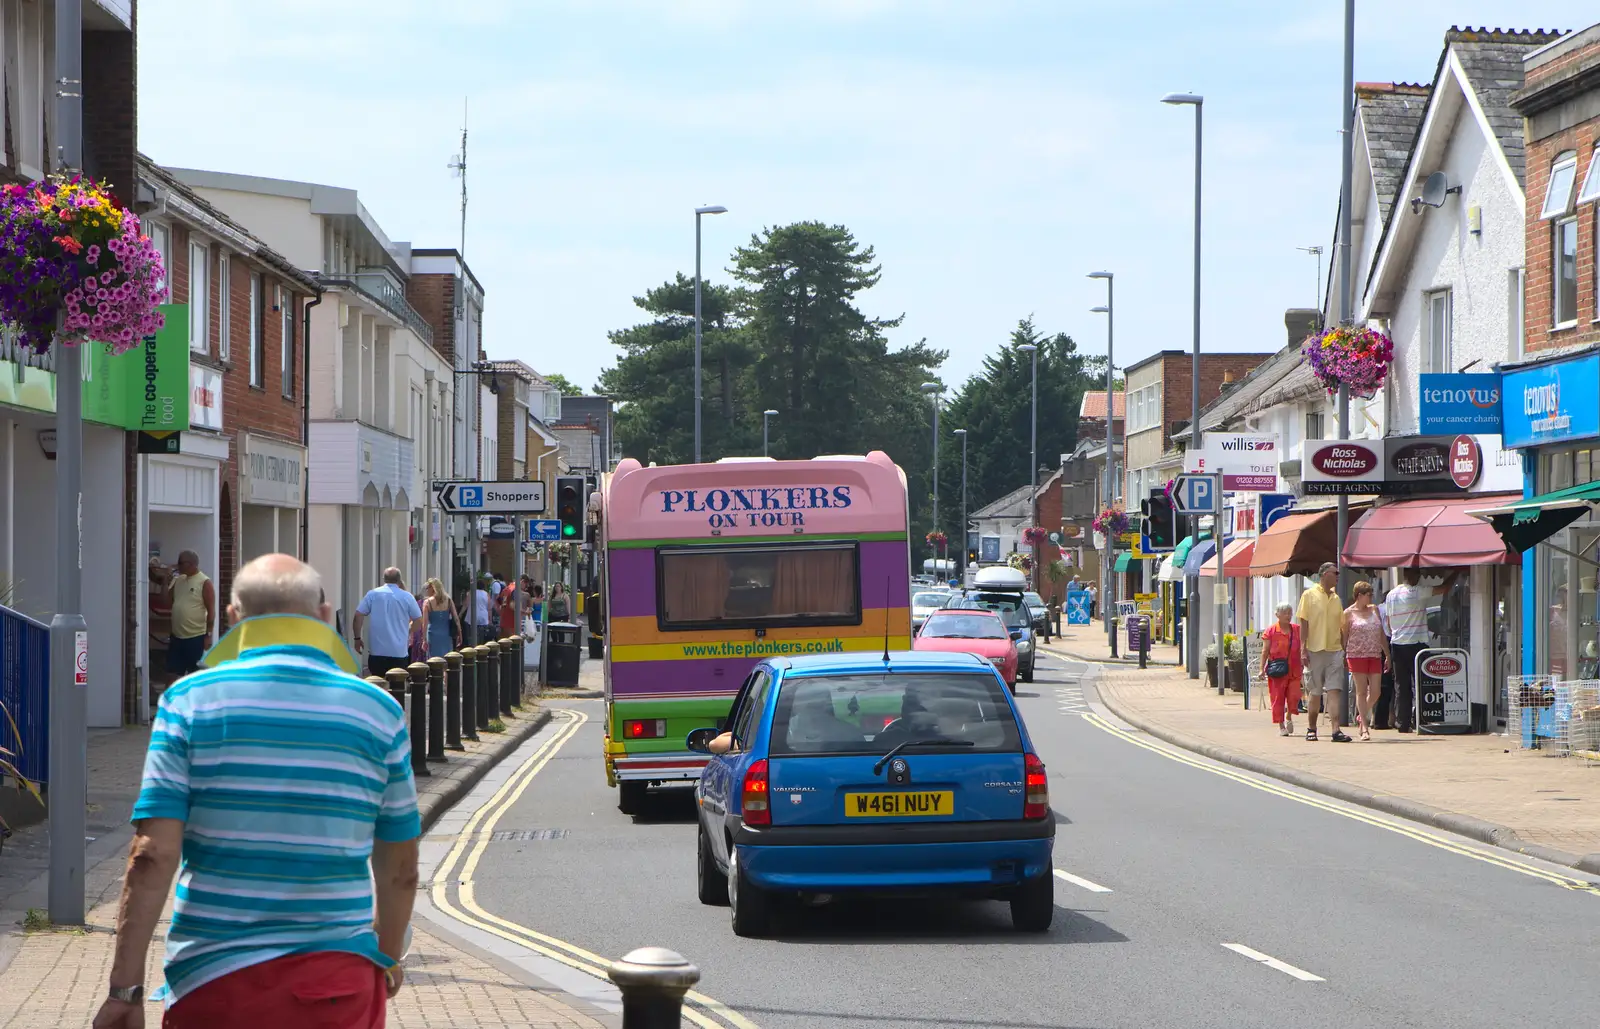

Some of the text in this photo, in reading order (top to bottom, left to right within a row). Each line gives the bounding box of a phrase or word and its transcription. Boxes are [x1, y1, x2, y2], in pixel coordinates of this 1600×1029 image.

[141, 334, 159, 427] The co-operat
[1424, 387, 1499, 404] tenovus
[1523, 382, 1557, 415] tenovus
[160, 396, 174, 425] food
[1426, 413, 1500, 425] your cancer charity
[1222, 438, 1254, 451] willis
[1331, 448, 1357, 458] Ross
[1457, 441, 1469, 457] Ross
[1322, 459, 1367, 469] Nicholas
[1397, 455, 1444, 475] ESTATE AGENTS
[1193, 481, 1208, 508] P
[1308, 484, 1382, 492] ESTATE AGENTS
[462, 489, 476, 506] P
[486, 491, 540, 503] Shoppers
[660, 486, 852, 513] PLONKERS
[708, 511, 805, 528] ON TOUR
[1120, 603, 1135, 616] OPEN
[683, 638, 844, 657] www.theplonkers.co.uk
[1424, 692, 1464, 704] OPEN
[857, 794, 942, 813] W461 NUY
